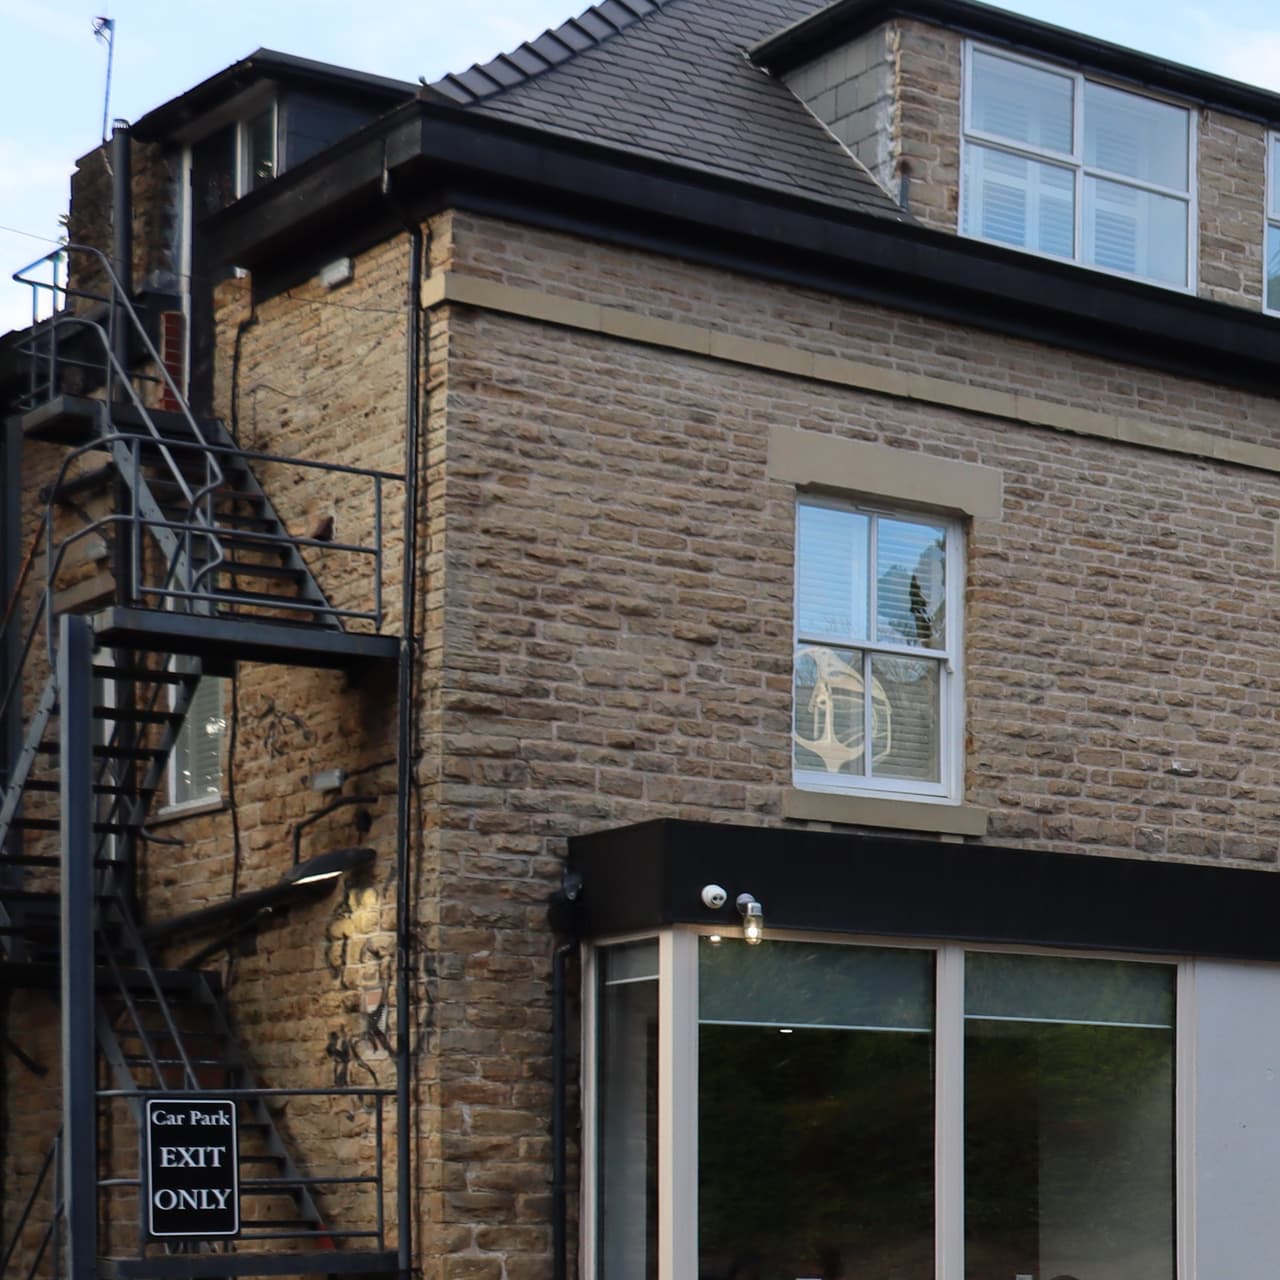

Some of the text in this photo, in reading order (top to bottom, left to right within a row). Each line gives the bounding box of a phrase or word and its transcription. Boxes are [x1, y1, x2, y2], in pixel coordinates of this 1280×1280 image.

[151, 1110, 231, 1126] Car Park
[159, 1146, 226, 1168] EXIT
[154, 1188, 233, 1211] ONLY
